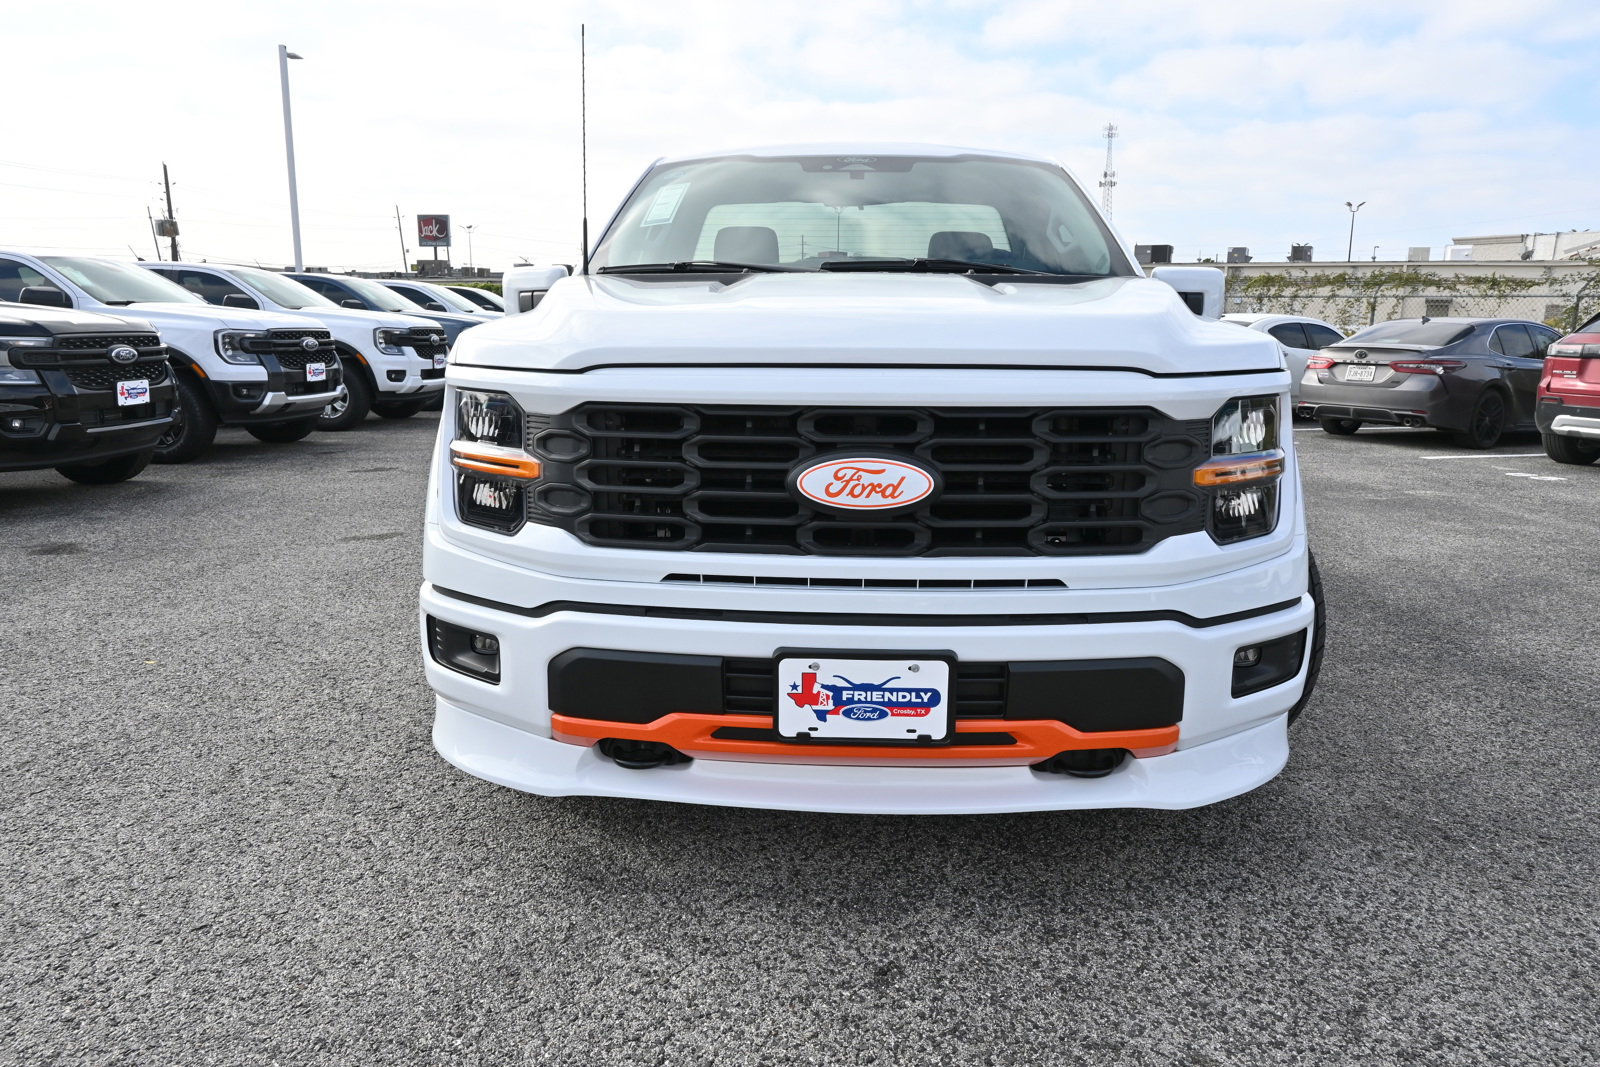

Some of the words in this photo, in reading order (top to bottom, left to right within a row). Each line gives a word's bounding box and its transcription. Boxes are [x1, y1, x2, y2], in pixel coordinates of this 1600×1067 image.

[420, 218, 447, 237] Jack
[824, 466, 906, 499] Ford
[841, 690, 932, 703] FRIENDLY
[850, 707, 880, 720] Ford
